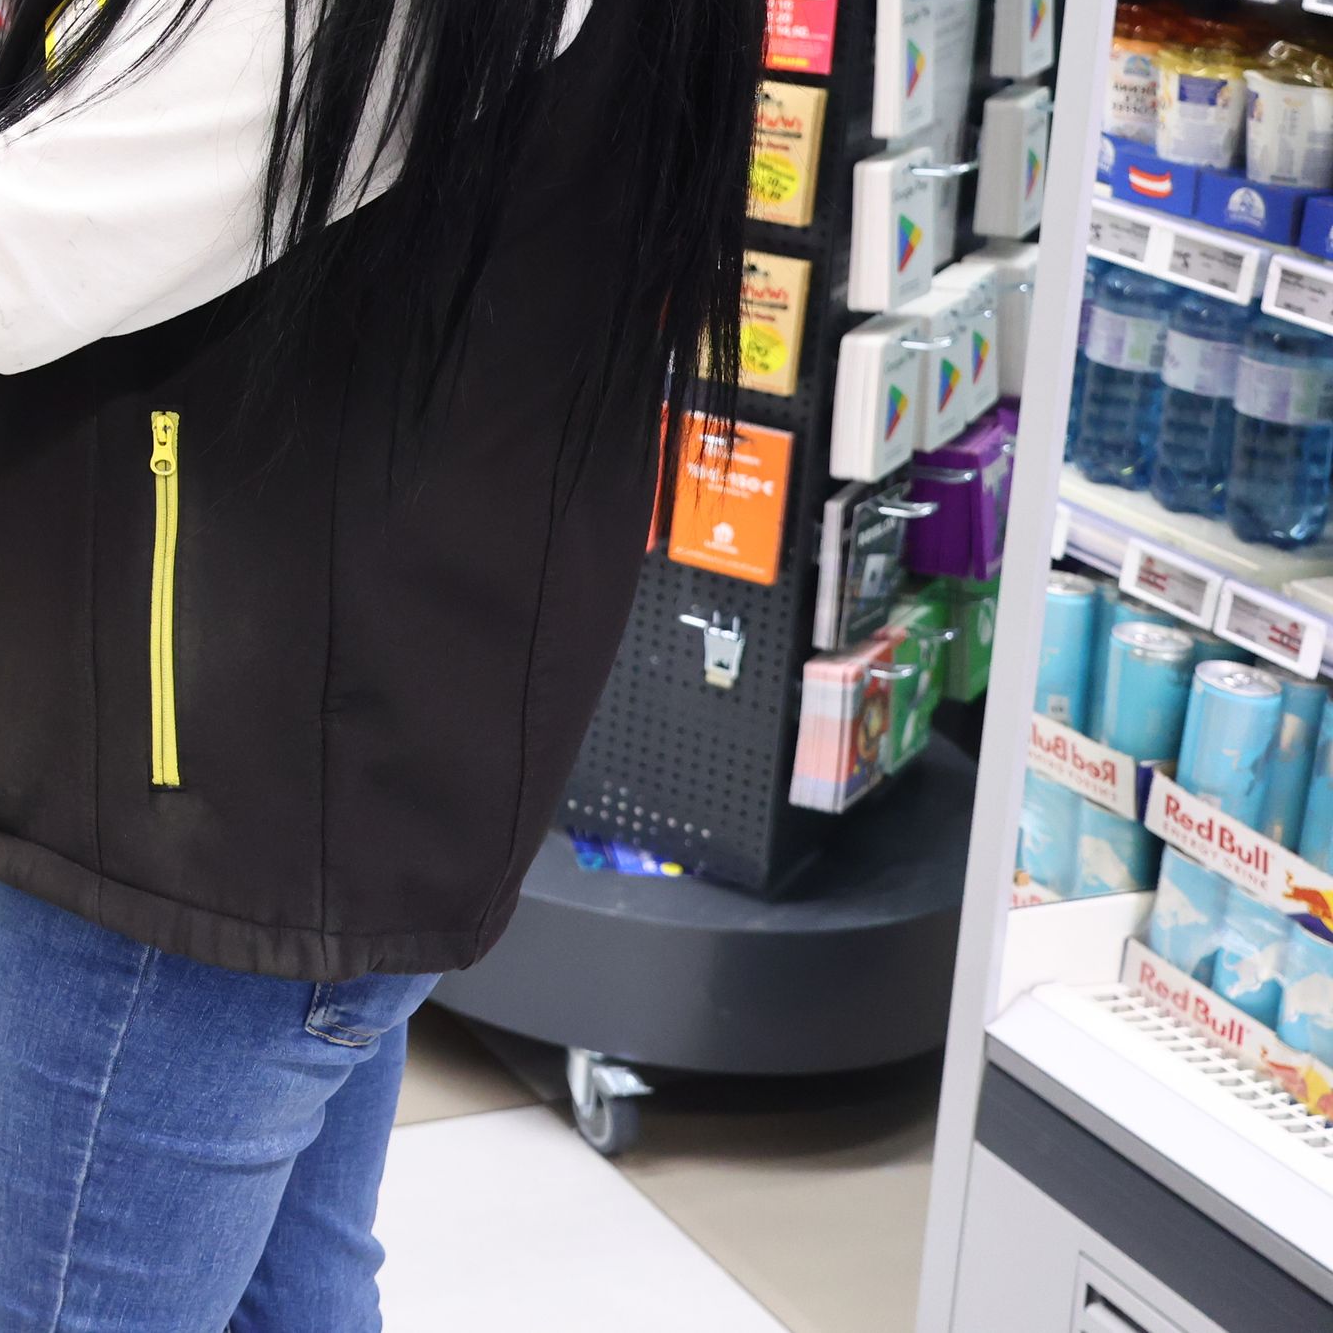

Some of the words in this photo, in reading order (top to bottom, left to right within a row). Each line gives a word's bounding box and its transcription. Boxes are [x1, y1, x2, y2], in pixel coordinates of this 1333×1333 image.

[1164, 793, 1213, 842] Red
[1219, 826, 1270, 875] Bull
[1139, 960, 1189, 1011] Red
[1194, 996, 1244, 1047] Bull
